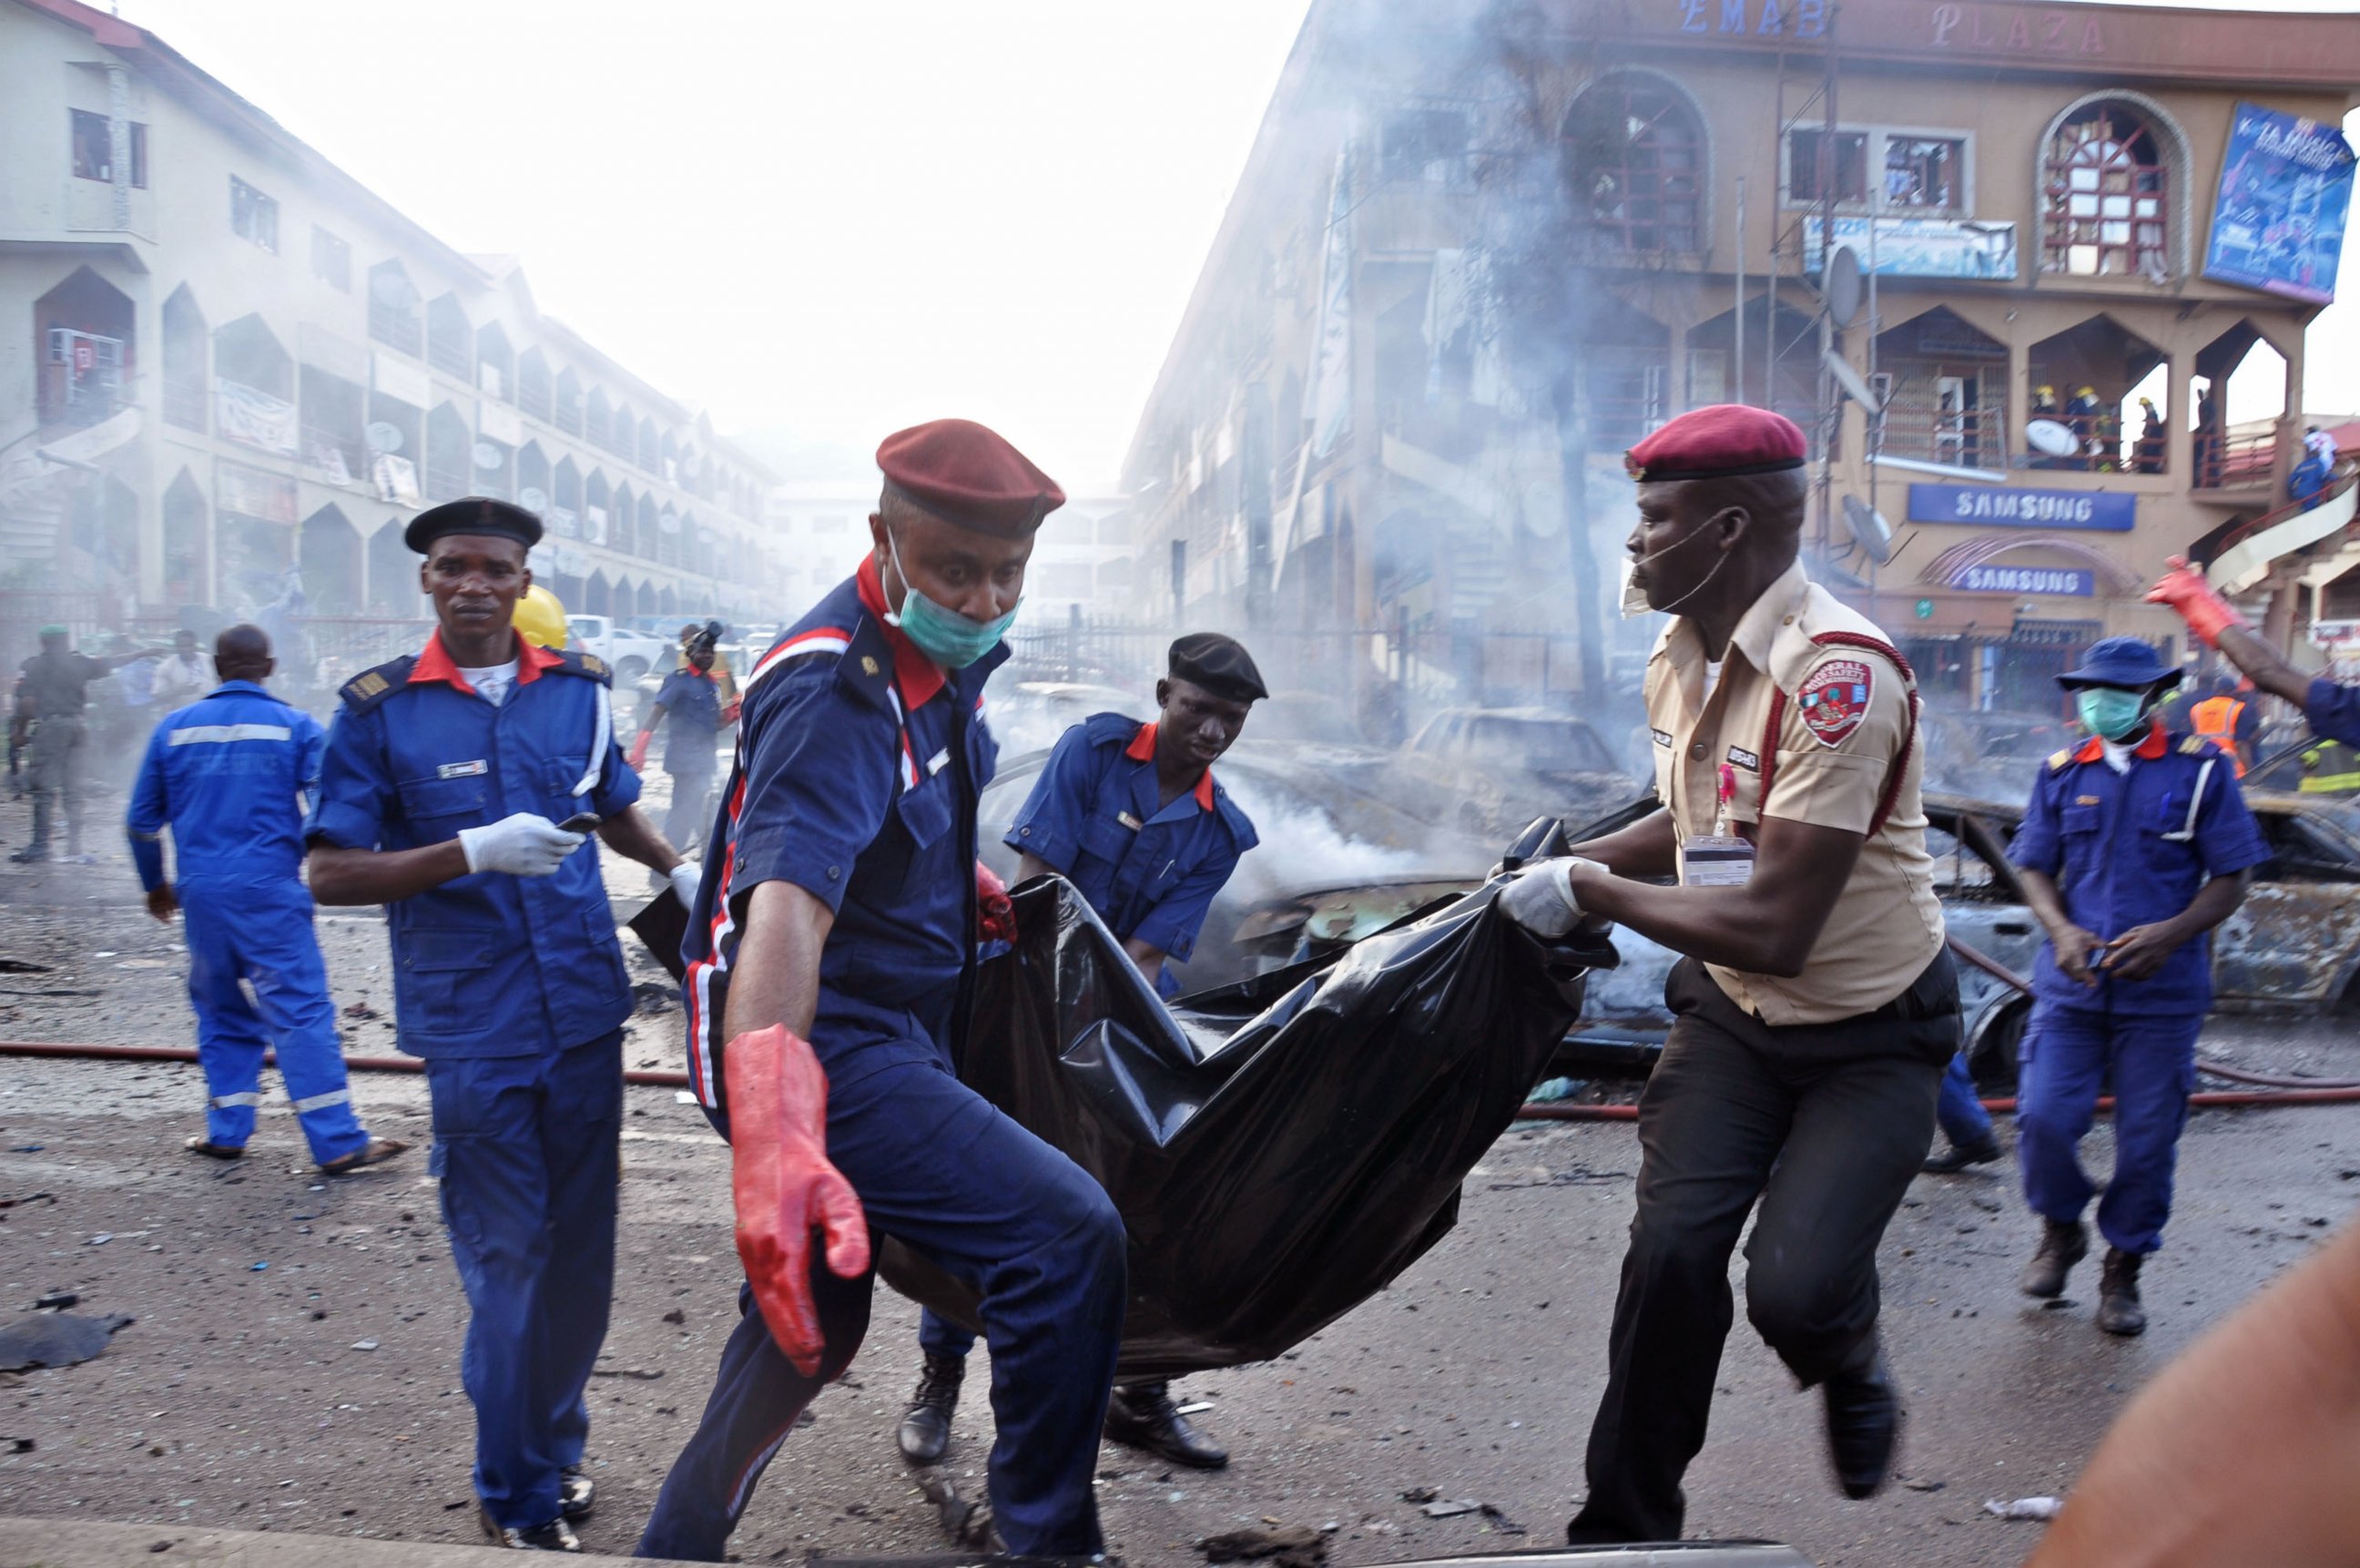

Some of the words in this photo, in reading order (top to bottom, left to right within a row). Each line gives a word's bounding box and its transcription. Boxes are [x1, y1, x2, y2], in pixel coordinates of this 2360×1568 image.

[1680, 0, 1826, 37] EMAB
[1929, 3, 2106, 55] PLAZA
[1955, 492, 2093, 523] SAMSUNG
[1967, 568, 2080, 593] SAMSUNG
